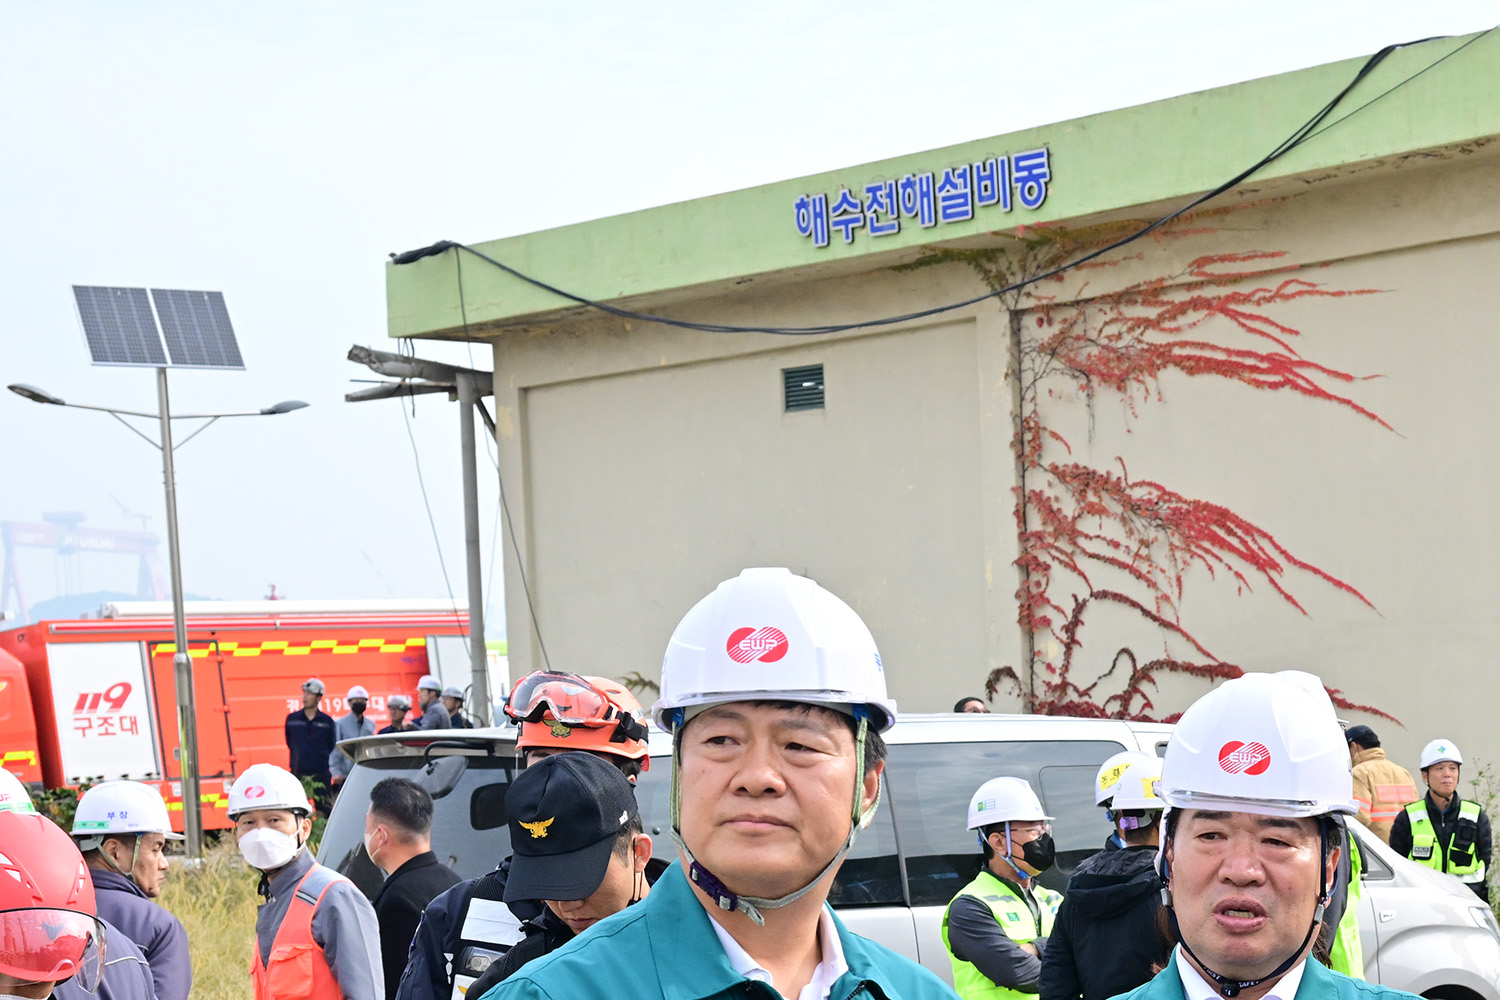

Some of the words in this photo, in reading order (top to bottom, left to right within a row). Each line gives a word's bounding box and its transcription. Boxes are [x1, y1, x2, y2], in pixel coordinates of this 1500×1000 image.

[794, 147, 1051, 247] 해수전해설비동
[738, 638, 778, 652] EWP
[73, 681, 133, 714] 119
[73, 715, 139, 738] 구조대
[1228, 752, 1263, 764] EWP
